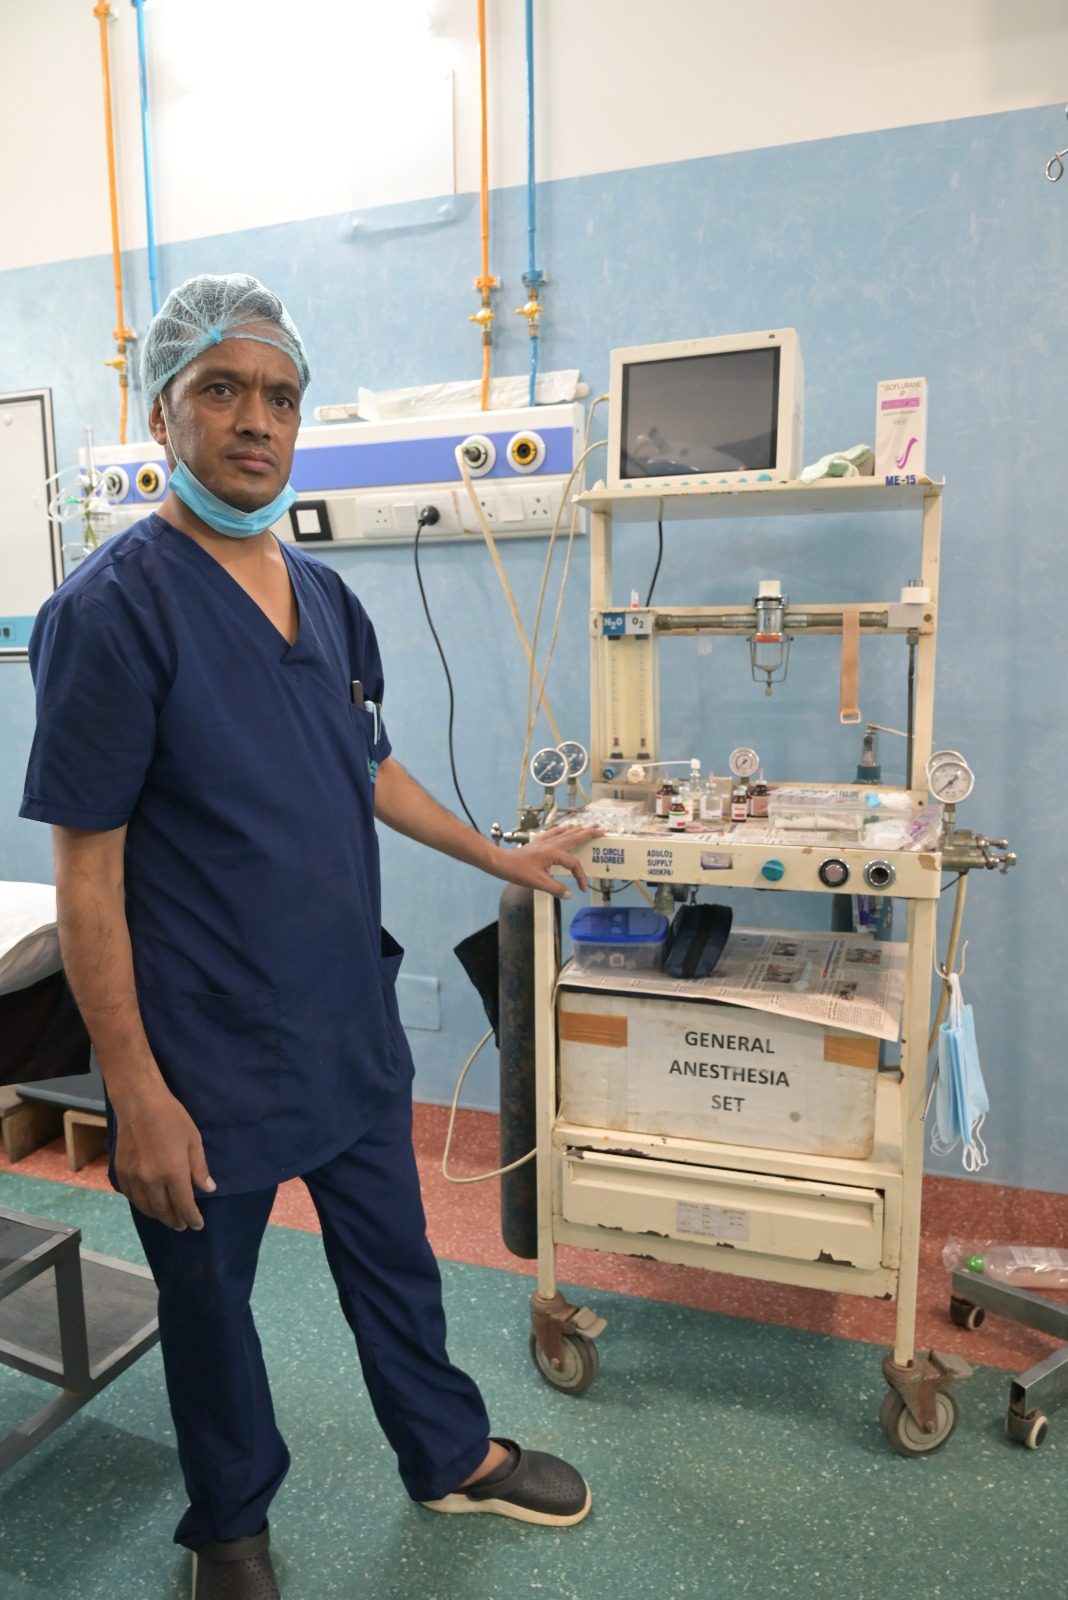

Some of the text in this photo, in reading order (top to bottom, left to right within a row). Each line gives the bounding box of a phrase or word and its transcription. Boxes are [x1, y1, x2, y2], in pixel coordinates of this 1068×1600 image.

[885, 475, 916, 487] ME-15
[592, 847, 624, 856] TO CIRCLE
[647, 859, 673, 867] SUPPLY
[684, 1031, 775, 1054] GENERAL
[669, 1059, 790, 1087] ANESTHESIA
[711, 1094, 746, 1113] SET
